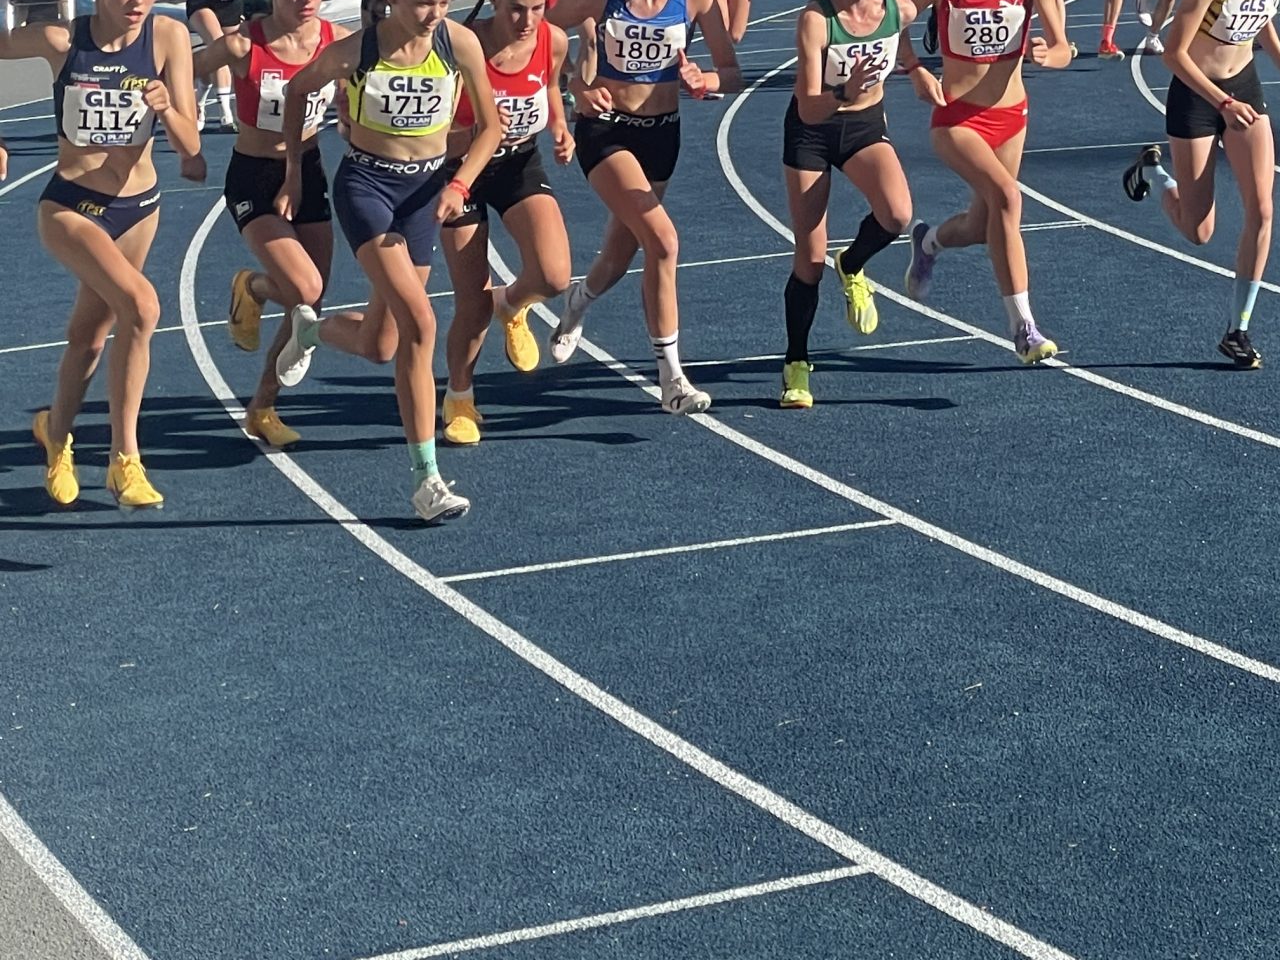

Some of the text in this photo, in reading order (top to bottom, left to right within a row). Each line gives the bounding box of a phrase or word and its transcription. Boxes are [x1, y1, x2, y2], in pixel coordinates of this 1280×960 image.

[965, 10, 1004, 25] GLS
[1225, 14, 1269, 31] 1772
[624, 24, 665, 42] GLS
[963, 25, 1010, 45] 280
[614, 39, 673, 61] 1801
[846, 41, 883, 58] GLS
[92, 65, 119, 73] CRAFT
[388, 75, 434, 93] GLS
[85, 91, 133, 108] GLS
[379, 94, 442, 115] 1712
[77, 109, 142, 131] 1114
[407, 116, 431, 124] PLAN
[106, 133, 132, 141] PLAN
[374, 161, 420, 175] PRO
